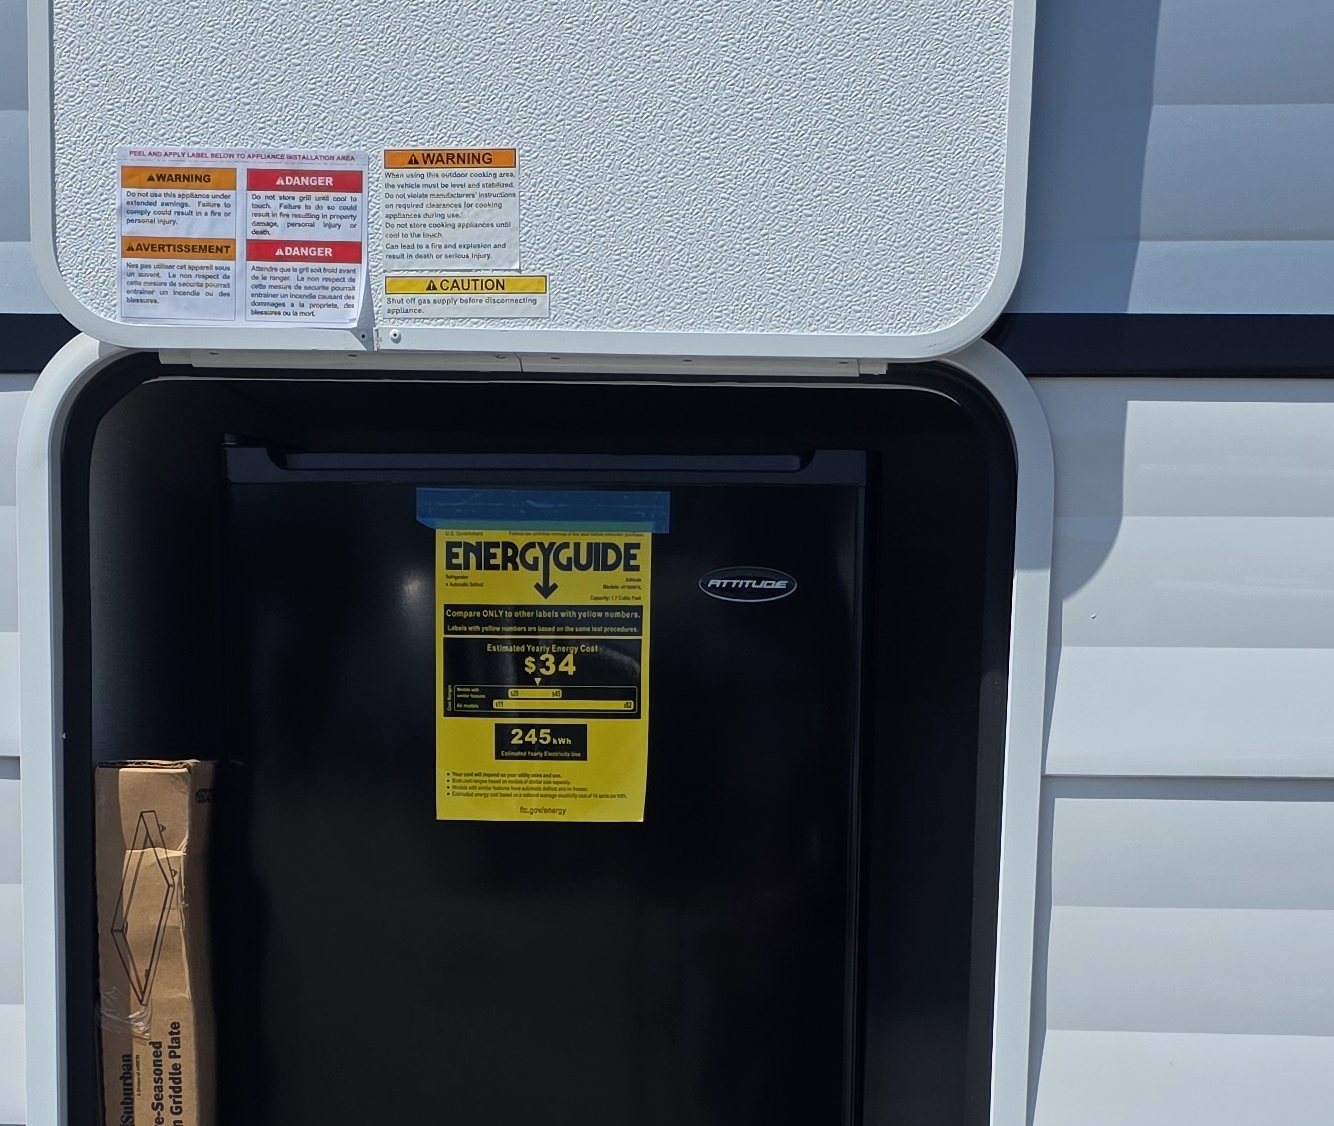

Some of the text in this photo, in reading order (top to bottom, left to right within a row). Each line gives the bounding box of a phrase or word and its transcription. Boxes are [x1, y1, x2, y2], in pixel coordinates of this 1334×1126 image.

[422, 153, 493, 164] WARNING
[156, 174, 211, 183] WARNING
[286, 176, 333, 186] DANGER
[136, 243, 231, 254] AVERTISSEMENT
[285, 247, 333, 256] DANGER
[440, 279, 505, 291] CAUTION
[433, 298, 457, 306] supply
[485, 297, 537, 306] disconnecting
[387, 307, 424, 315] appliance.
[445, 541, 641, 572] ENERGYGUIDE
[708, 580, 788, 588] ATTITUDE
[446, 609, 640, 620] Compare ONLY to other labels with yellow numbers.
[487, 644, 598, 654] Estimated Yearly Energy Cost
[524, 653, 576, 676] $34
[511, 729, 551, 745] 245
[168, 1022, 182, 1058] Plate
[120, 1054, 135, 1124] Suburban
[169, 1062, 184, 1115] Griddle
